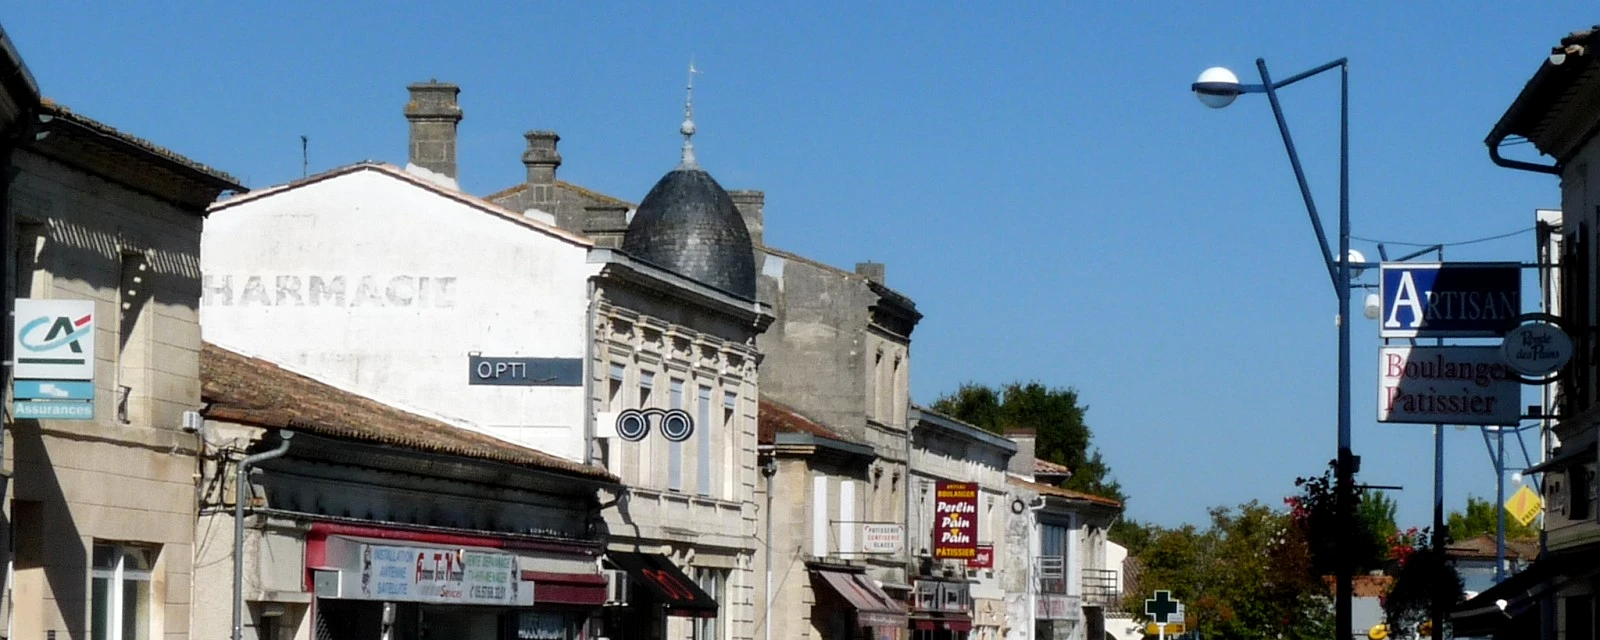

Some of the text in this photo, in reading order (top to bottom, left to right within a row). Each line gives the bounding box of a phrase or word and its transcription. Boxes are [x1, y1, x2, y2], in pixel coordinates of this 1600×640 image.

[1385, 270, 1518, 328] ARTISAN
[477, 361, 526, 379] OPTI
[1385, 387, 1496, 414] Patissier
[15, 403, 92, 416] Assurances
[937, 490, 975, 498] BOULANGER
[937, 501, 975, 513] Perlin
[941, 516, 970, 528] Pain
[941, 532, 970, 543] Pain
[377, 582, 407, 596] SATELLITE
